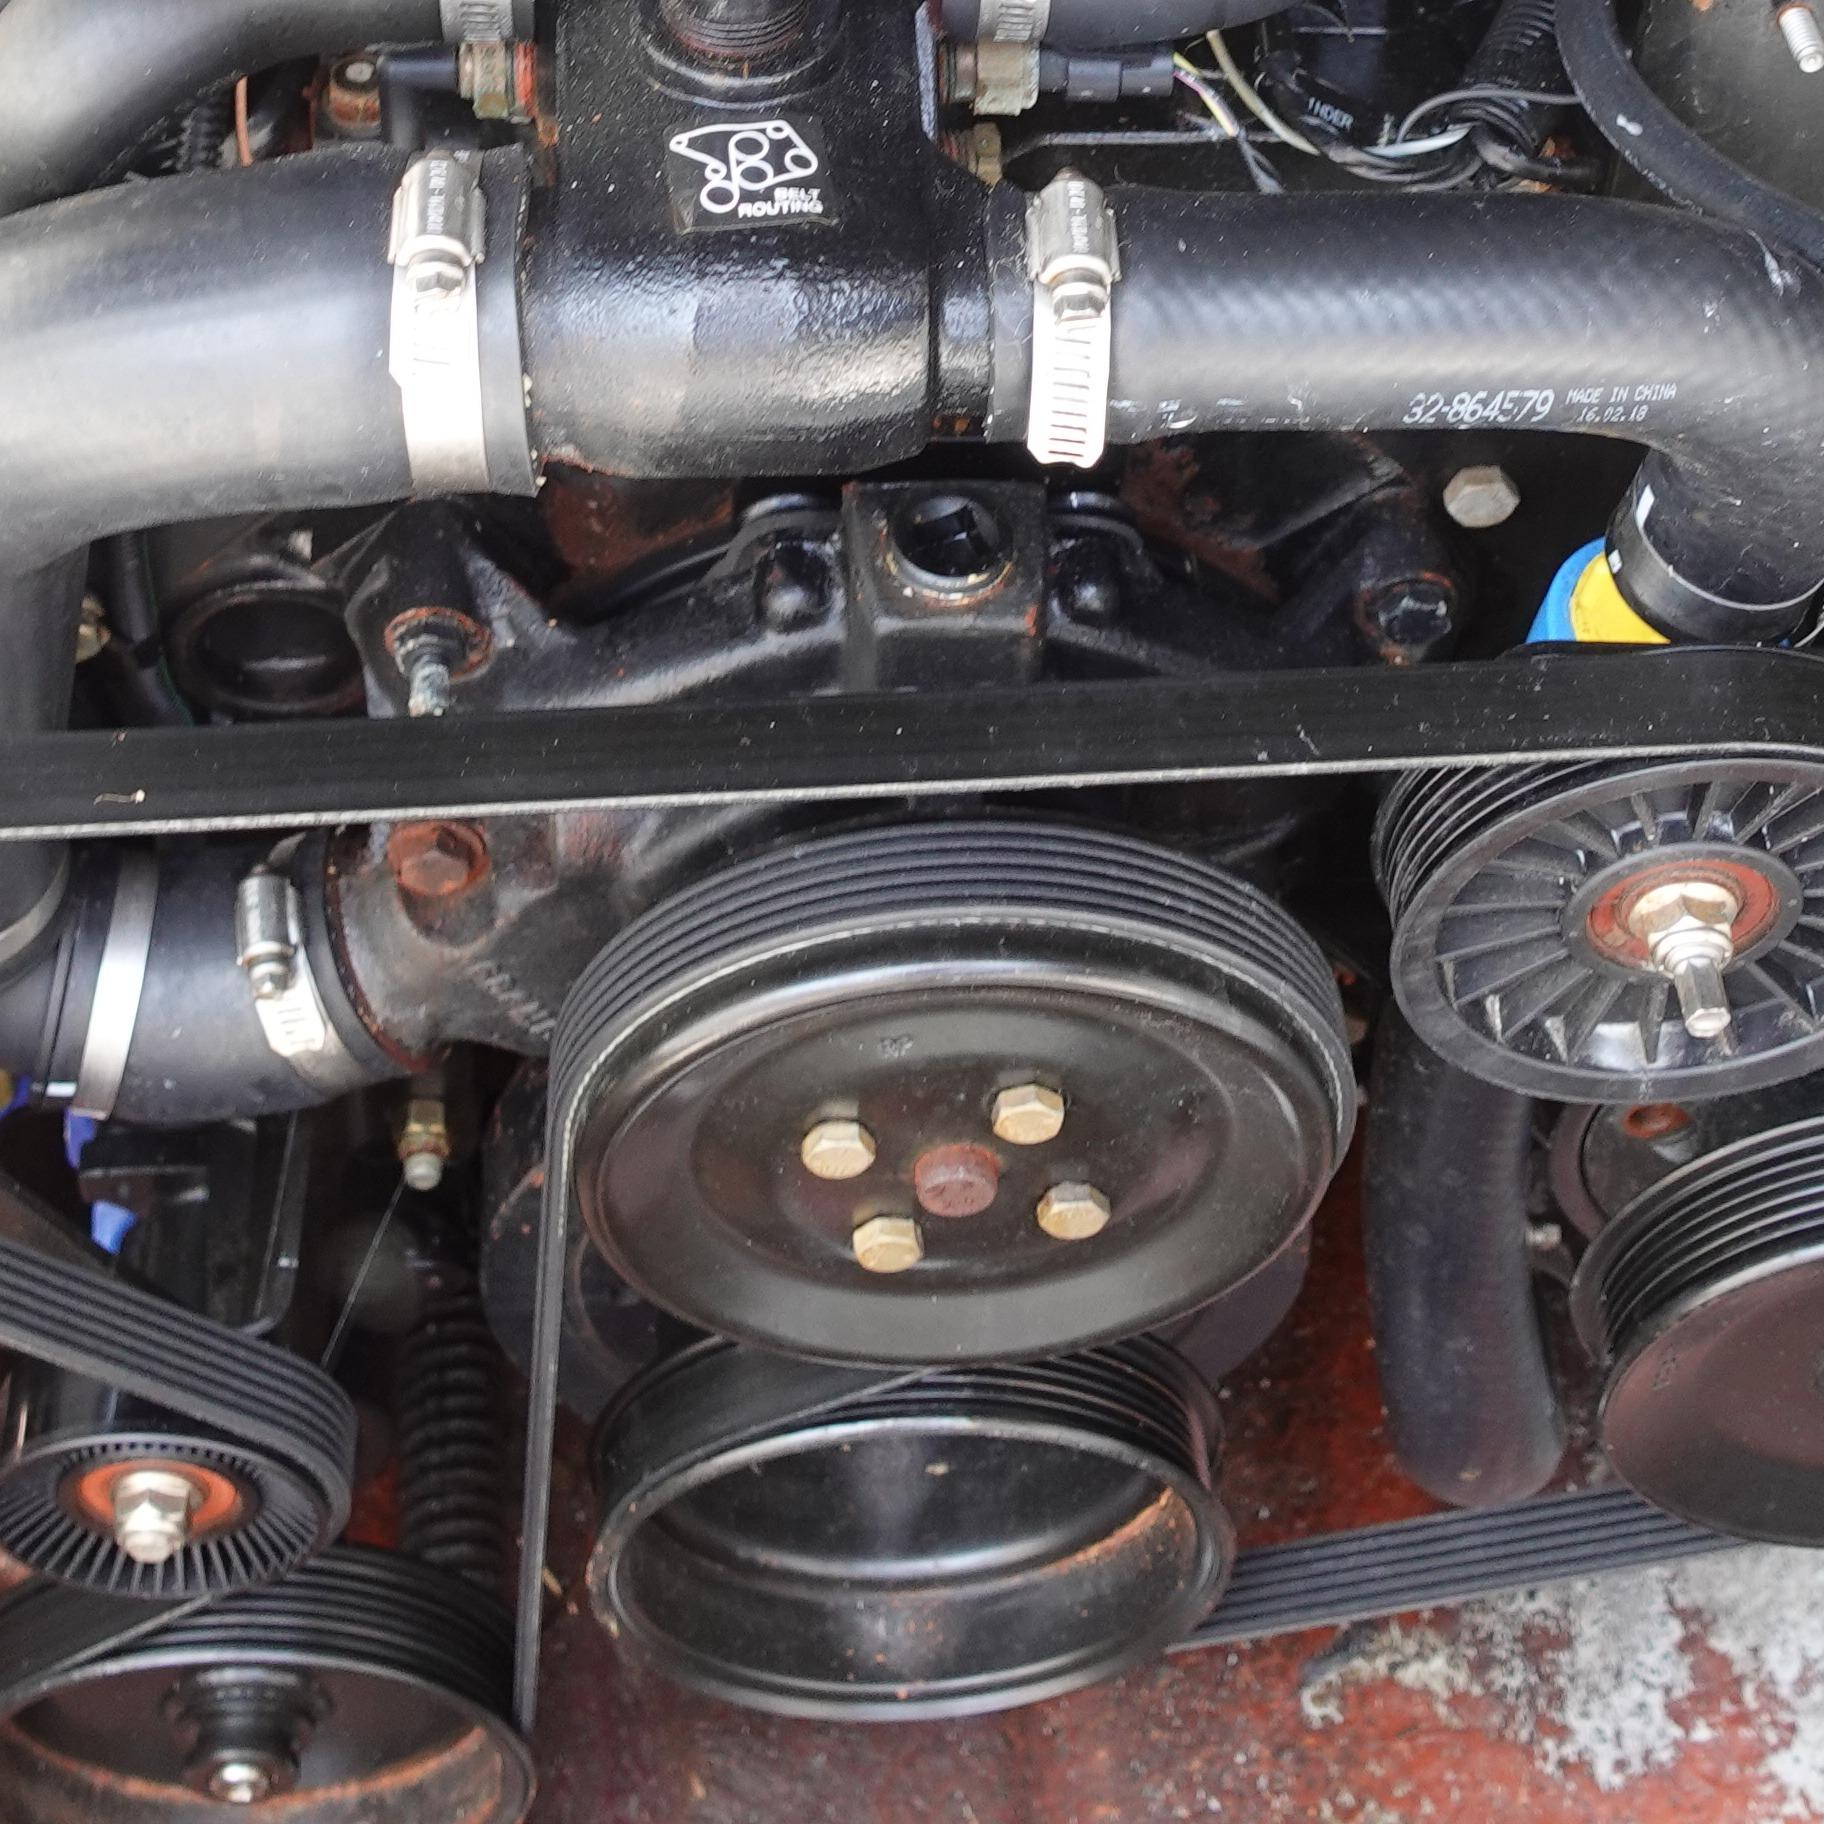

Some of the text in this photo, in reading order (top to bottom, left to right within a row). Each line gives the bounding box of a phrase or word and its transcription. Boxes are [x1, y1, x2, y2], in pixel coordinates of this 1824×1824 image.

[773, 187, 821, 201] BELT
[737, 199, 824, 219] ROUTING
[1402, 382, 1677, 424] 32-864579 MADE IN CHINA
